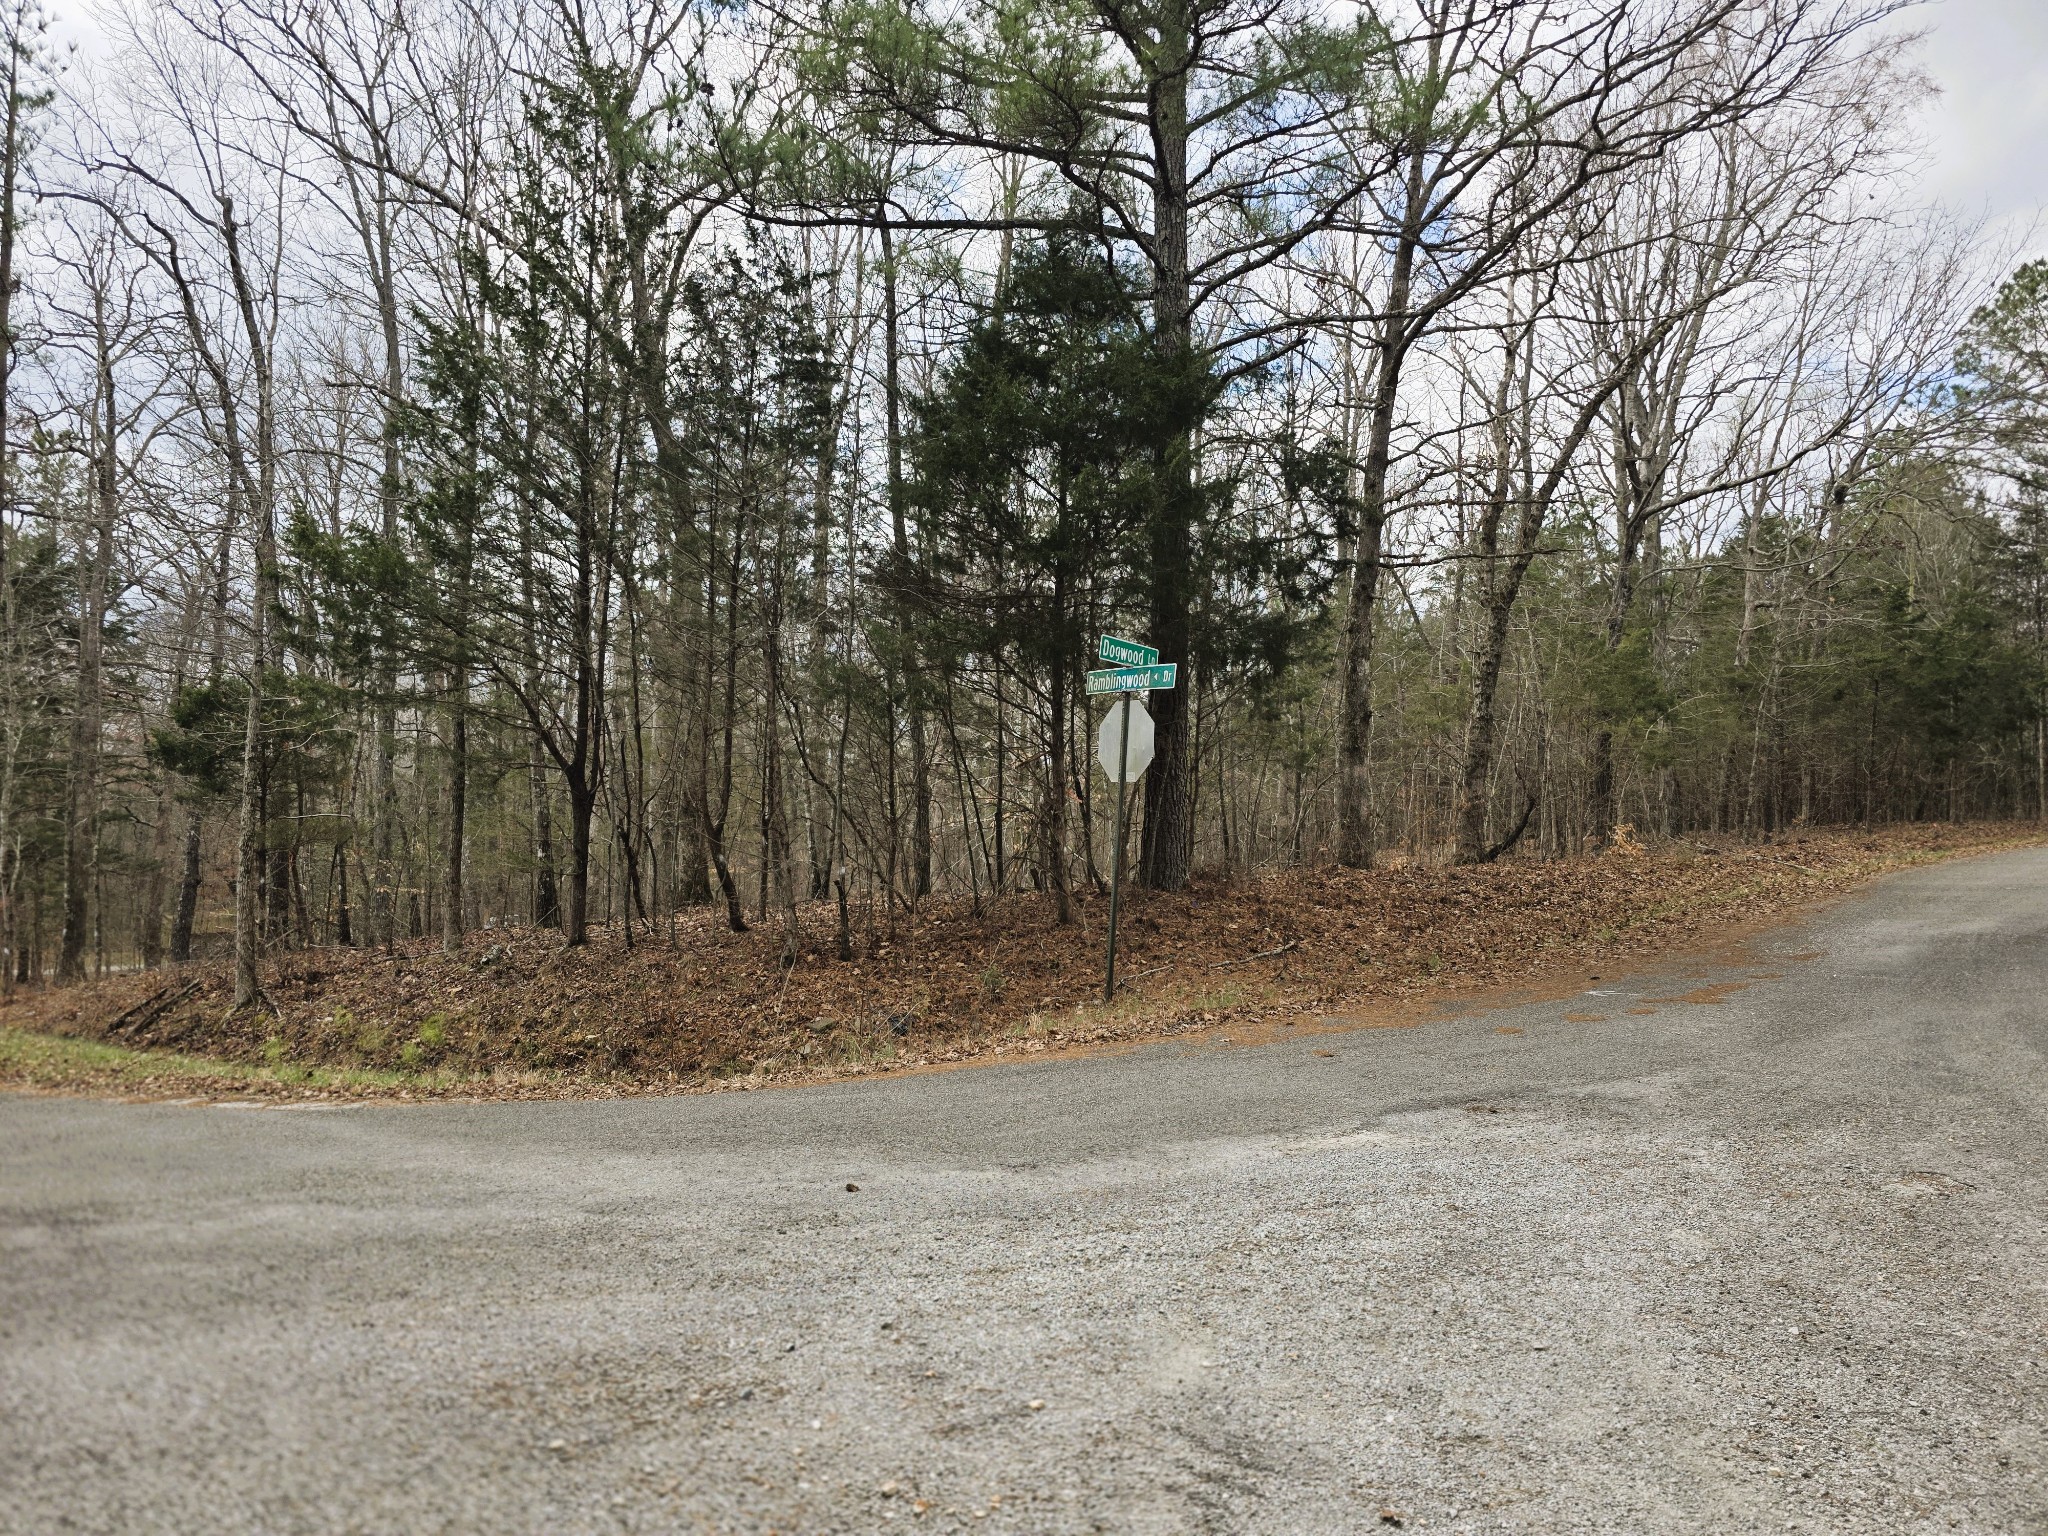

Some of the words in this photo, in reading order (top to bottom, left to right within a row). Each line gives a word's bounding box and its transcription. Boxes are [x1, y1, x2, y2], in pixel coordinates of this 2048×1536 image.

[1102, 639, 1145, 665] Dogwood
[1148, 654, 1155, 665] Ln
[1088, 670, 1151, 692] Ramblingwood
[1163, 670, 1172, 682] Dr
